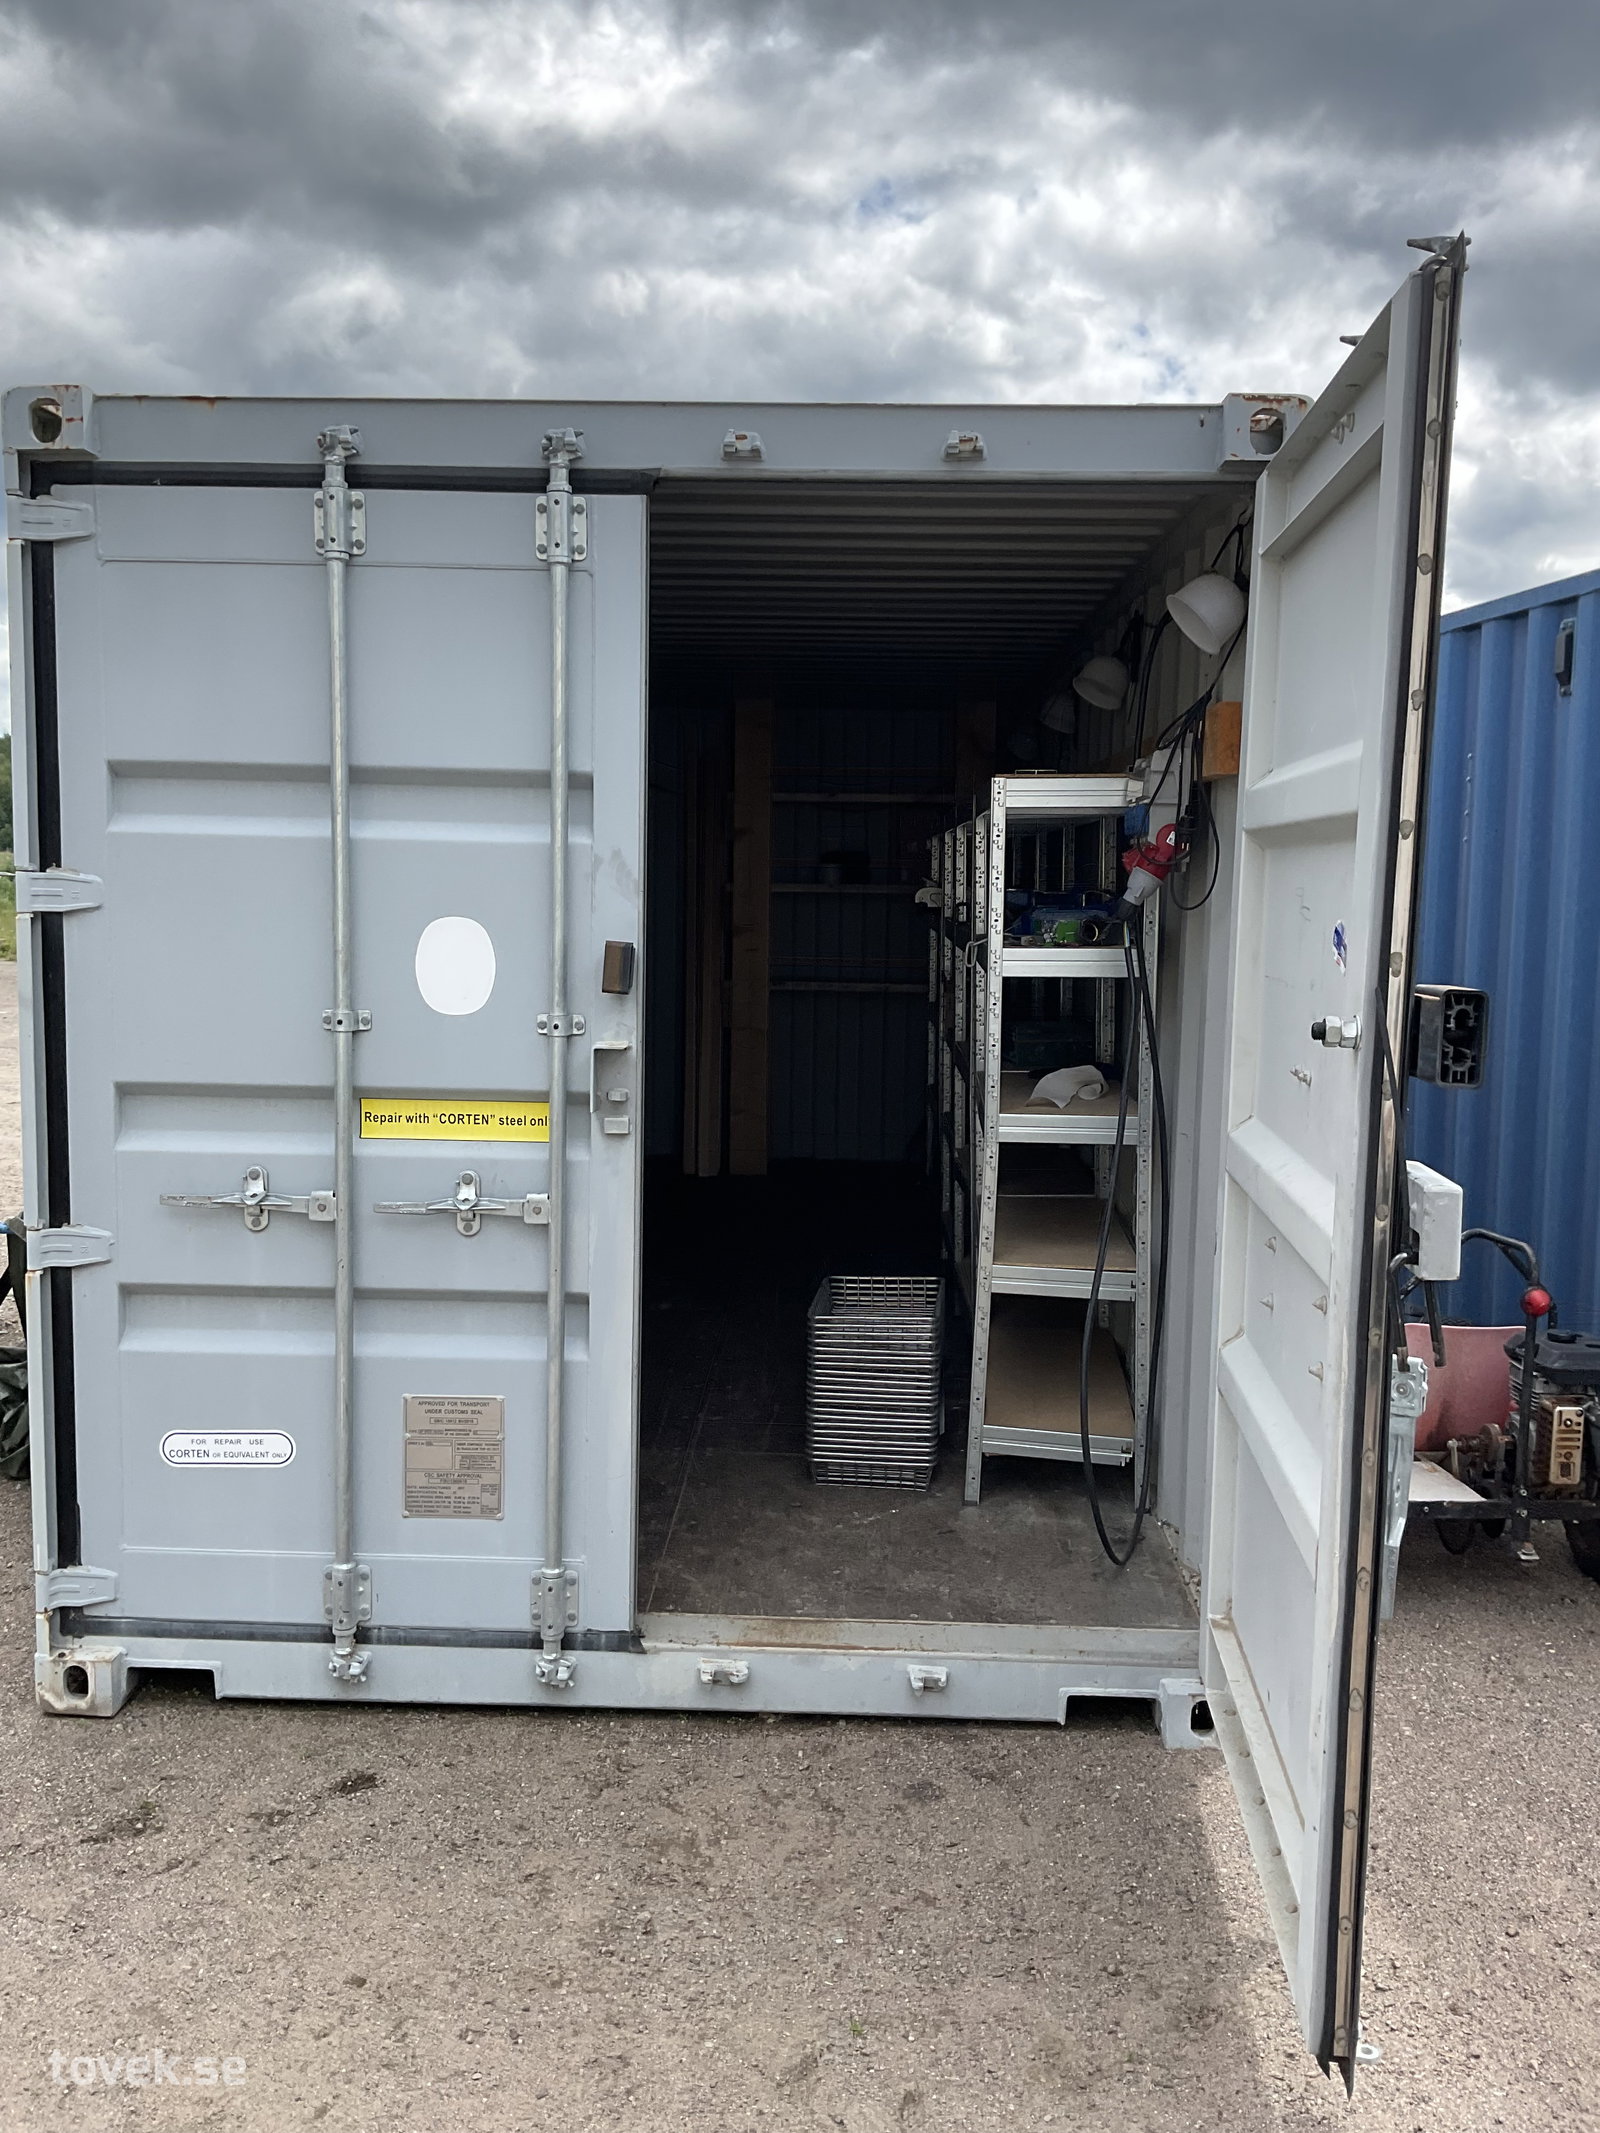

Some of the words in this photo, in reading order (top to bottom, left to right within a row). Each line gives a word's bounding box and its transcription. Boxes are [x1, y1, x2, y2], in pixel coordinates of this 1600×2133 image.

[364, 1111, 402, 1125] Repair
[405, 1112, 430, 1124] with
[498, 1115, 527, 1126] steel
[530, 1115, 550, 1127] onl
[168, 1449, 210, 1458] CORTEN
